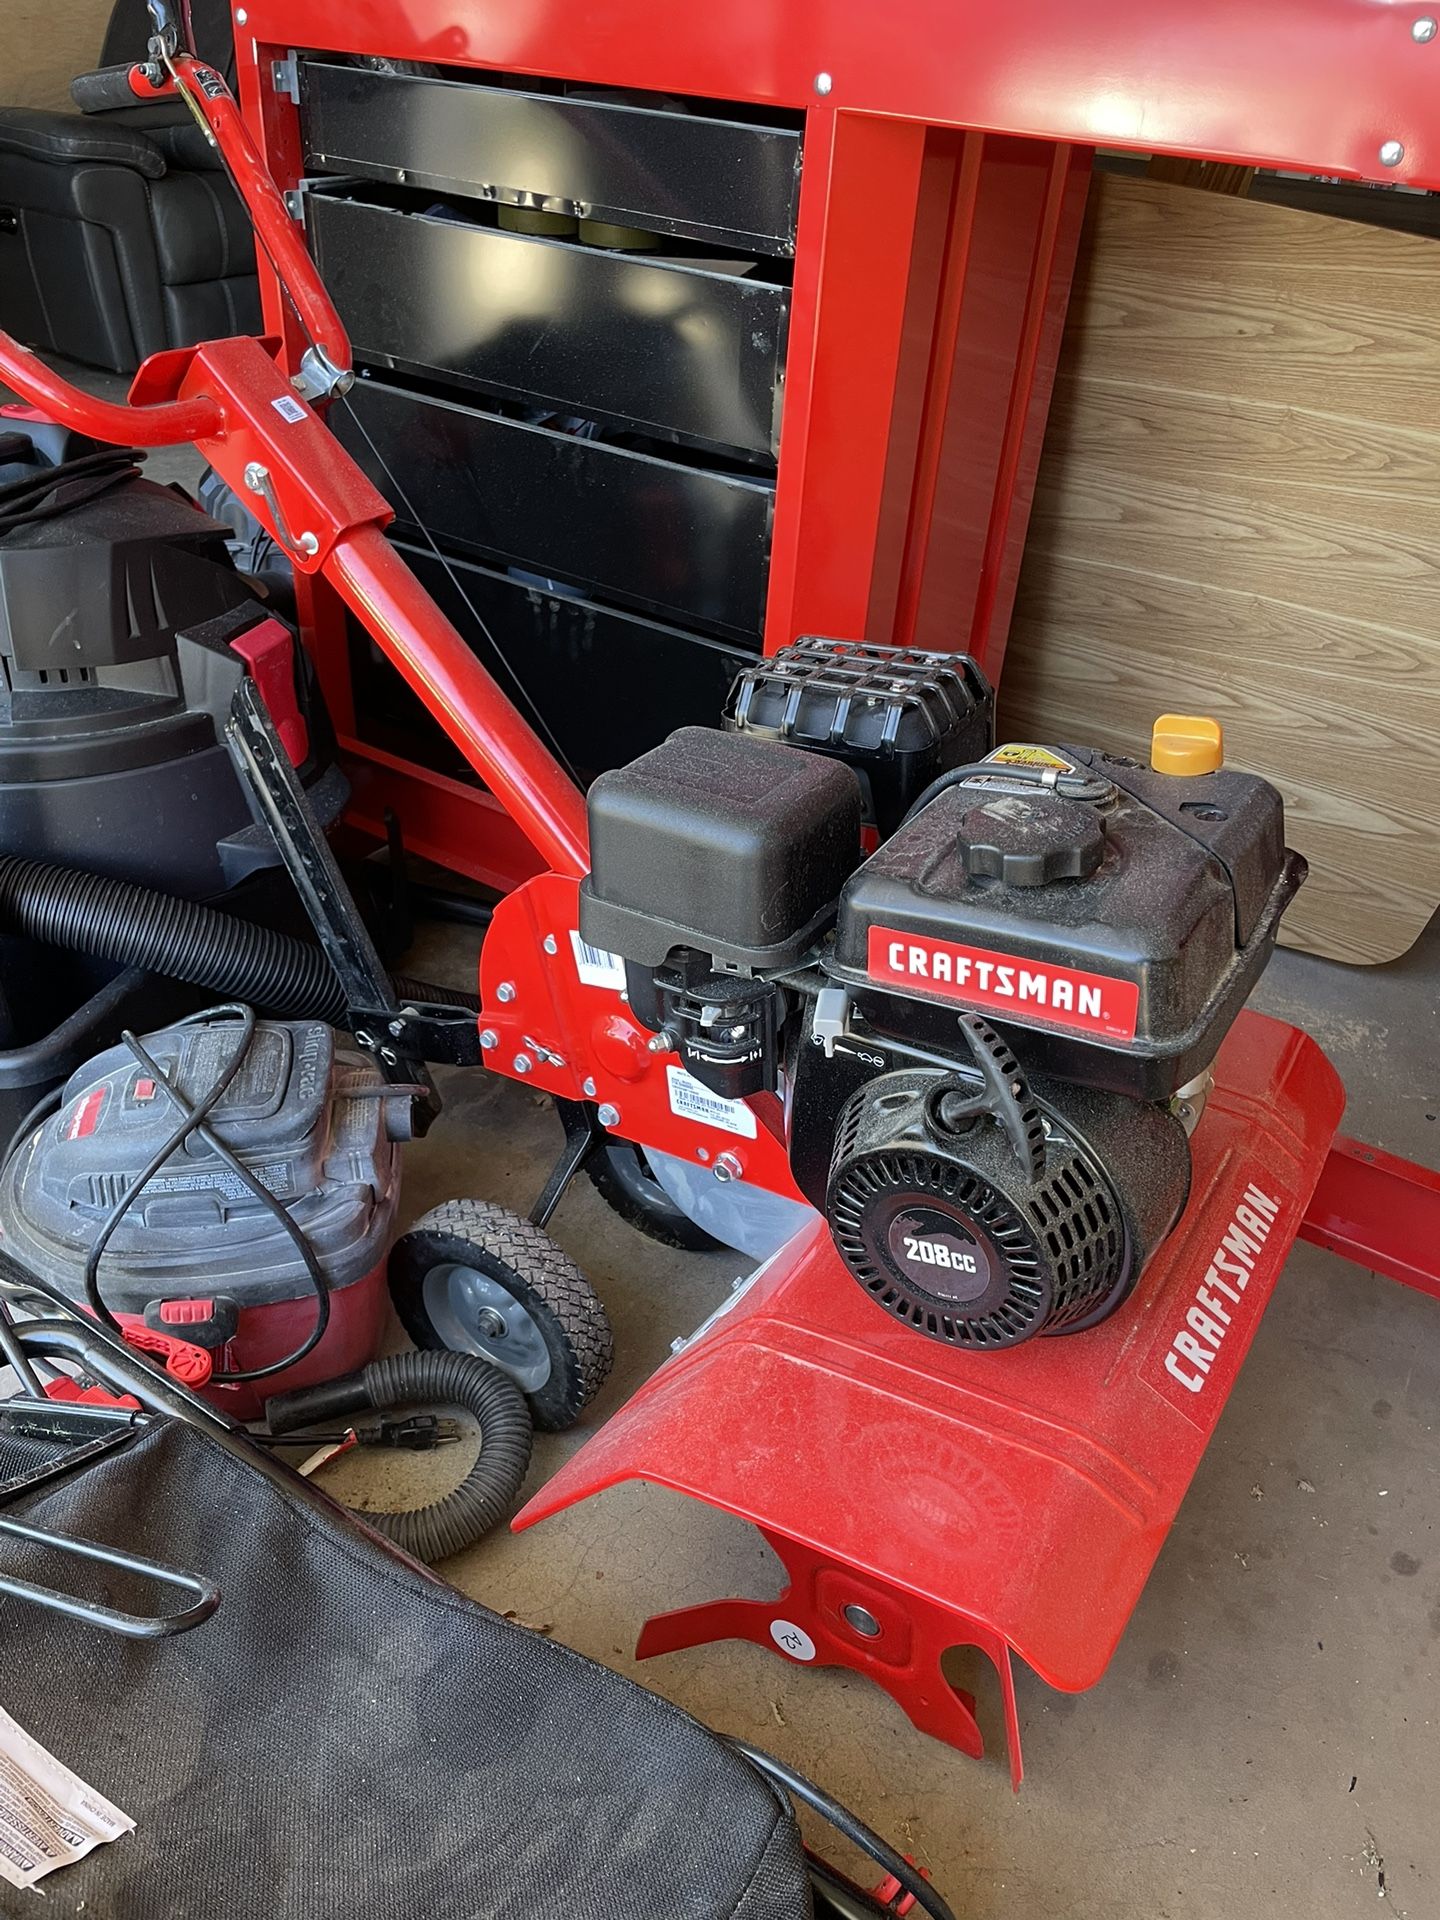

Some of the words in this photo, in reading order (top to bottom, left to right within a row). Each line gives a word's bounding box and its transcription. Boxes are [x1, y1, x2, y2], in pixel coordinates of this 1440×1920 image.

[888, 942, 1102, 1018] CRAFTSMAN
[1164, 1182, 1279, 1393] CRAFTSMAN
[0, 1840, 24, 1864] WARN
